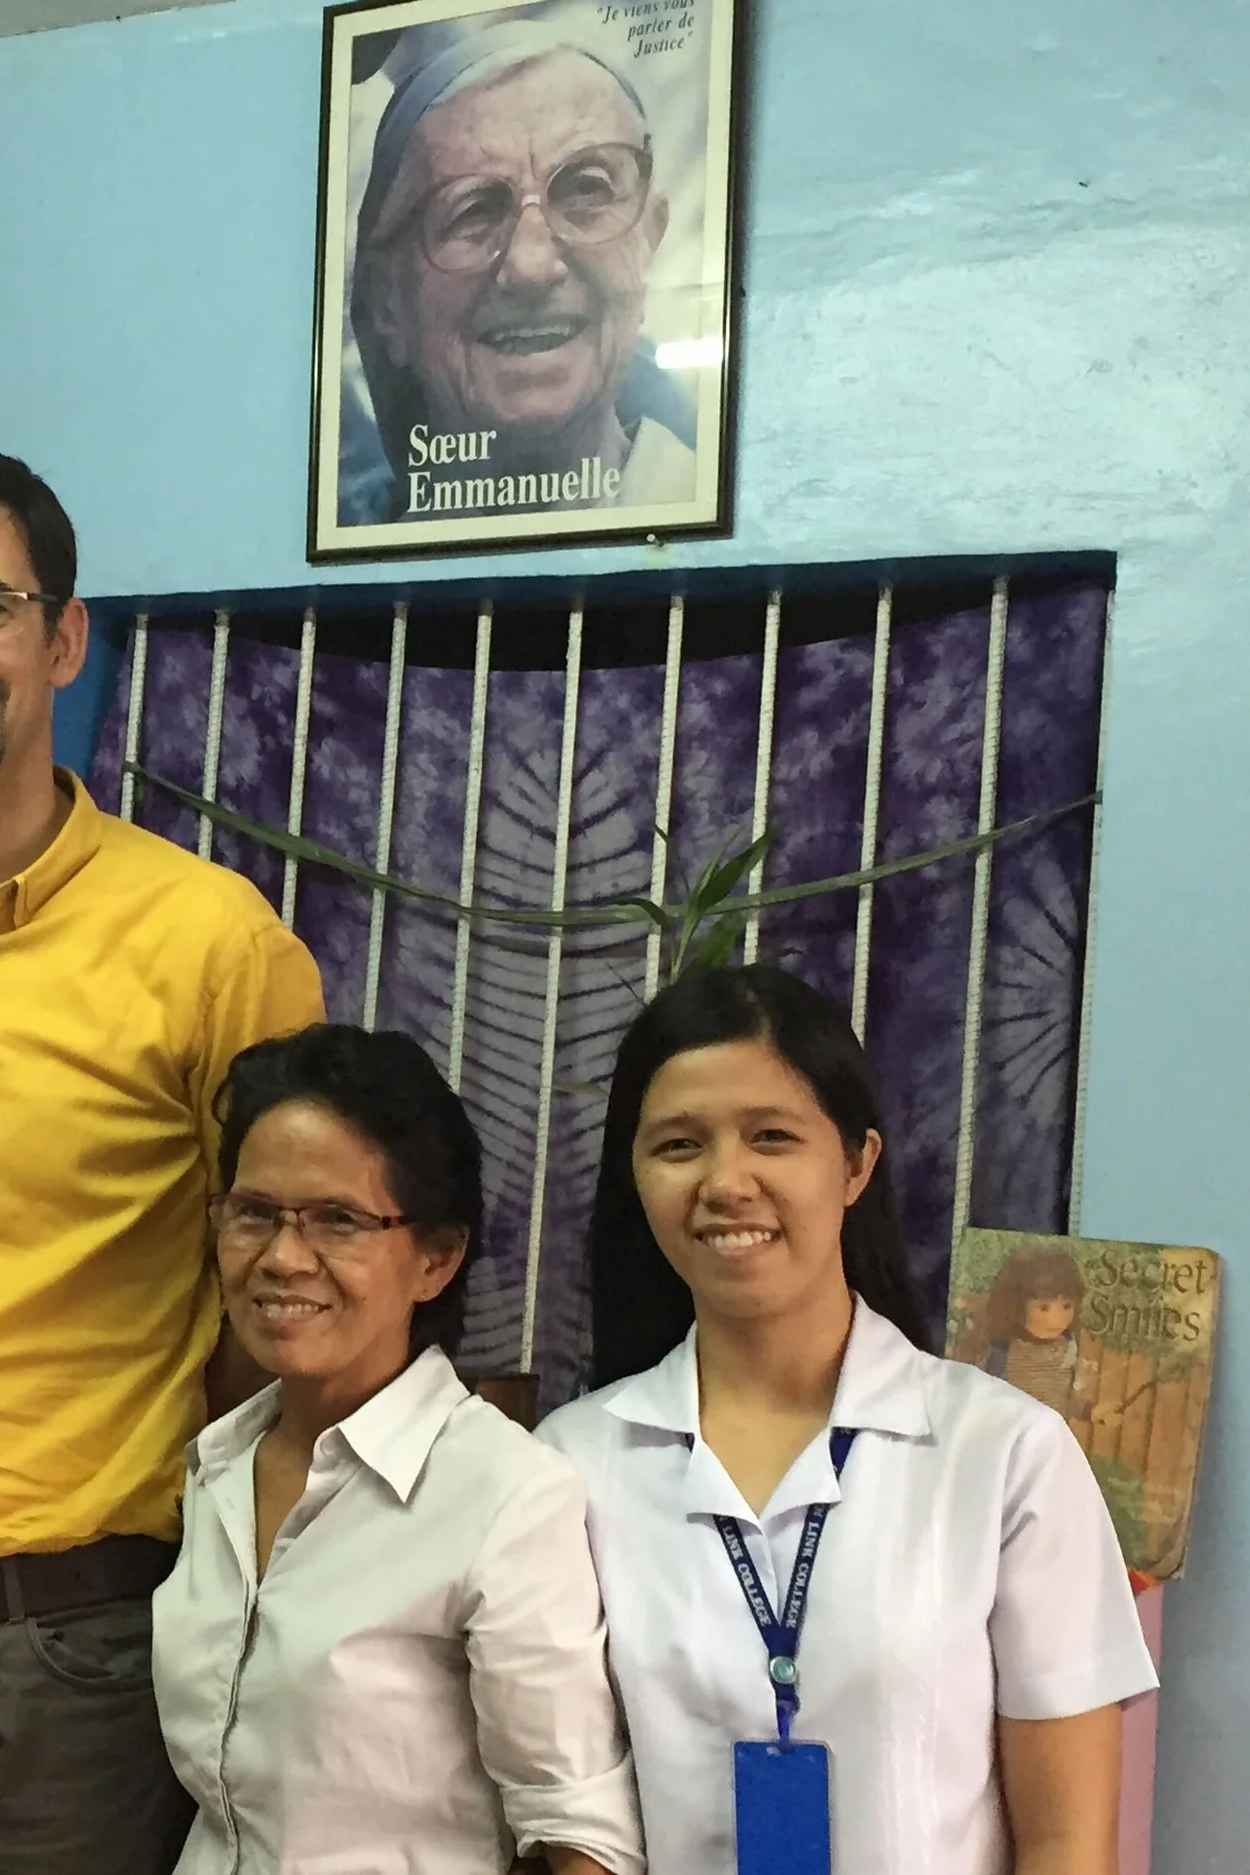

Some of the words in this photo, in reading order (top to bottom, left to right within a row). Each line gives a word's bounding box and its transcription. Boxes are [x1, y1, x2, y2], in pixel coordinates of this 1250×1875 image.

[624, 3, 658, 18] viens
[627, 17, 672, 42] parler
[678, 12, 694, 29] de
[408, 424, 497, 467] Sœur
[407, 457, 620, 513] Emmanuelle
[1086, 1248, 1208, 1295] Secret
[1083, 1291, 1201, 1342] Smiles
[801, 1521, 821, 1558] LINK
[722, 1525, 744, 1561] LINK
[737, 1562, 772, 1628] COLLEGE
[785, 1562, 810, 1629] COLLEGE
